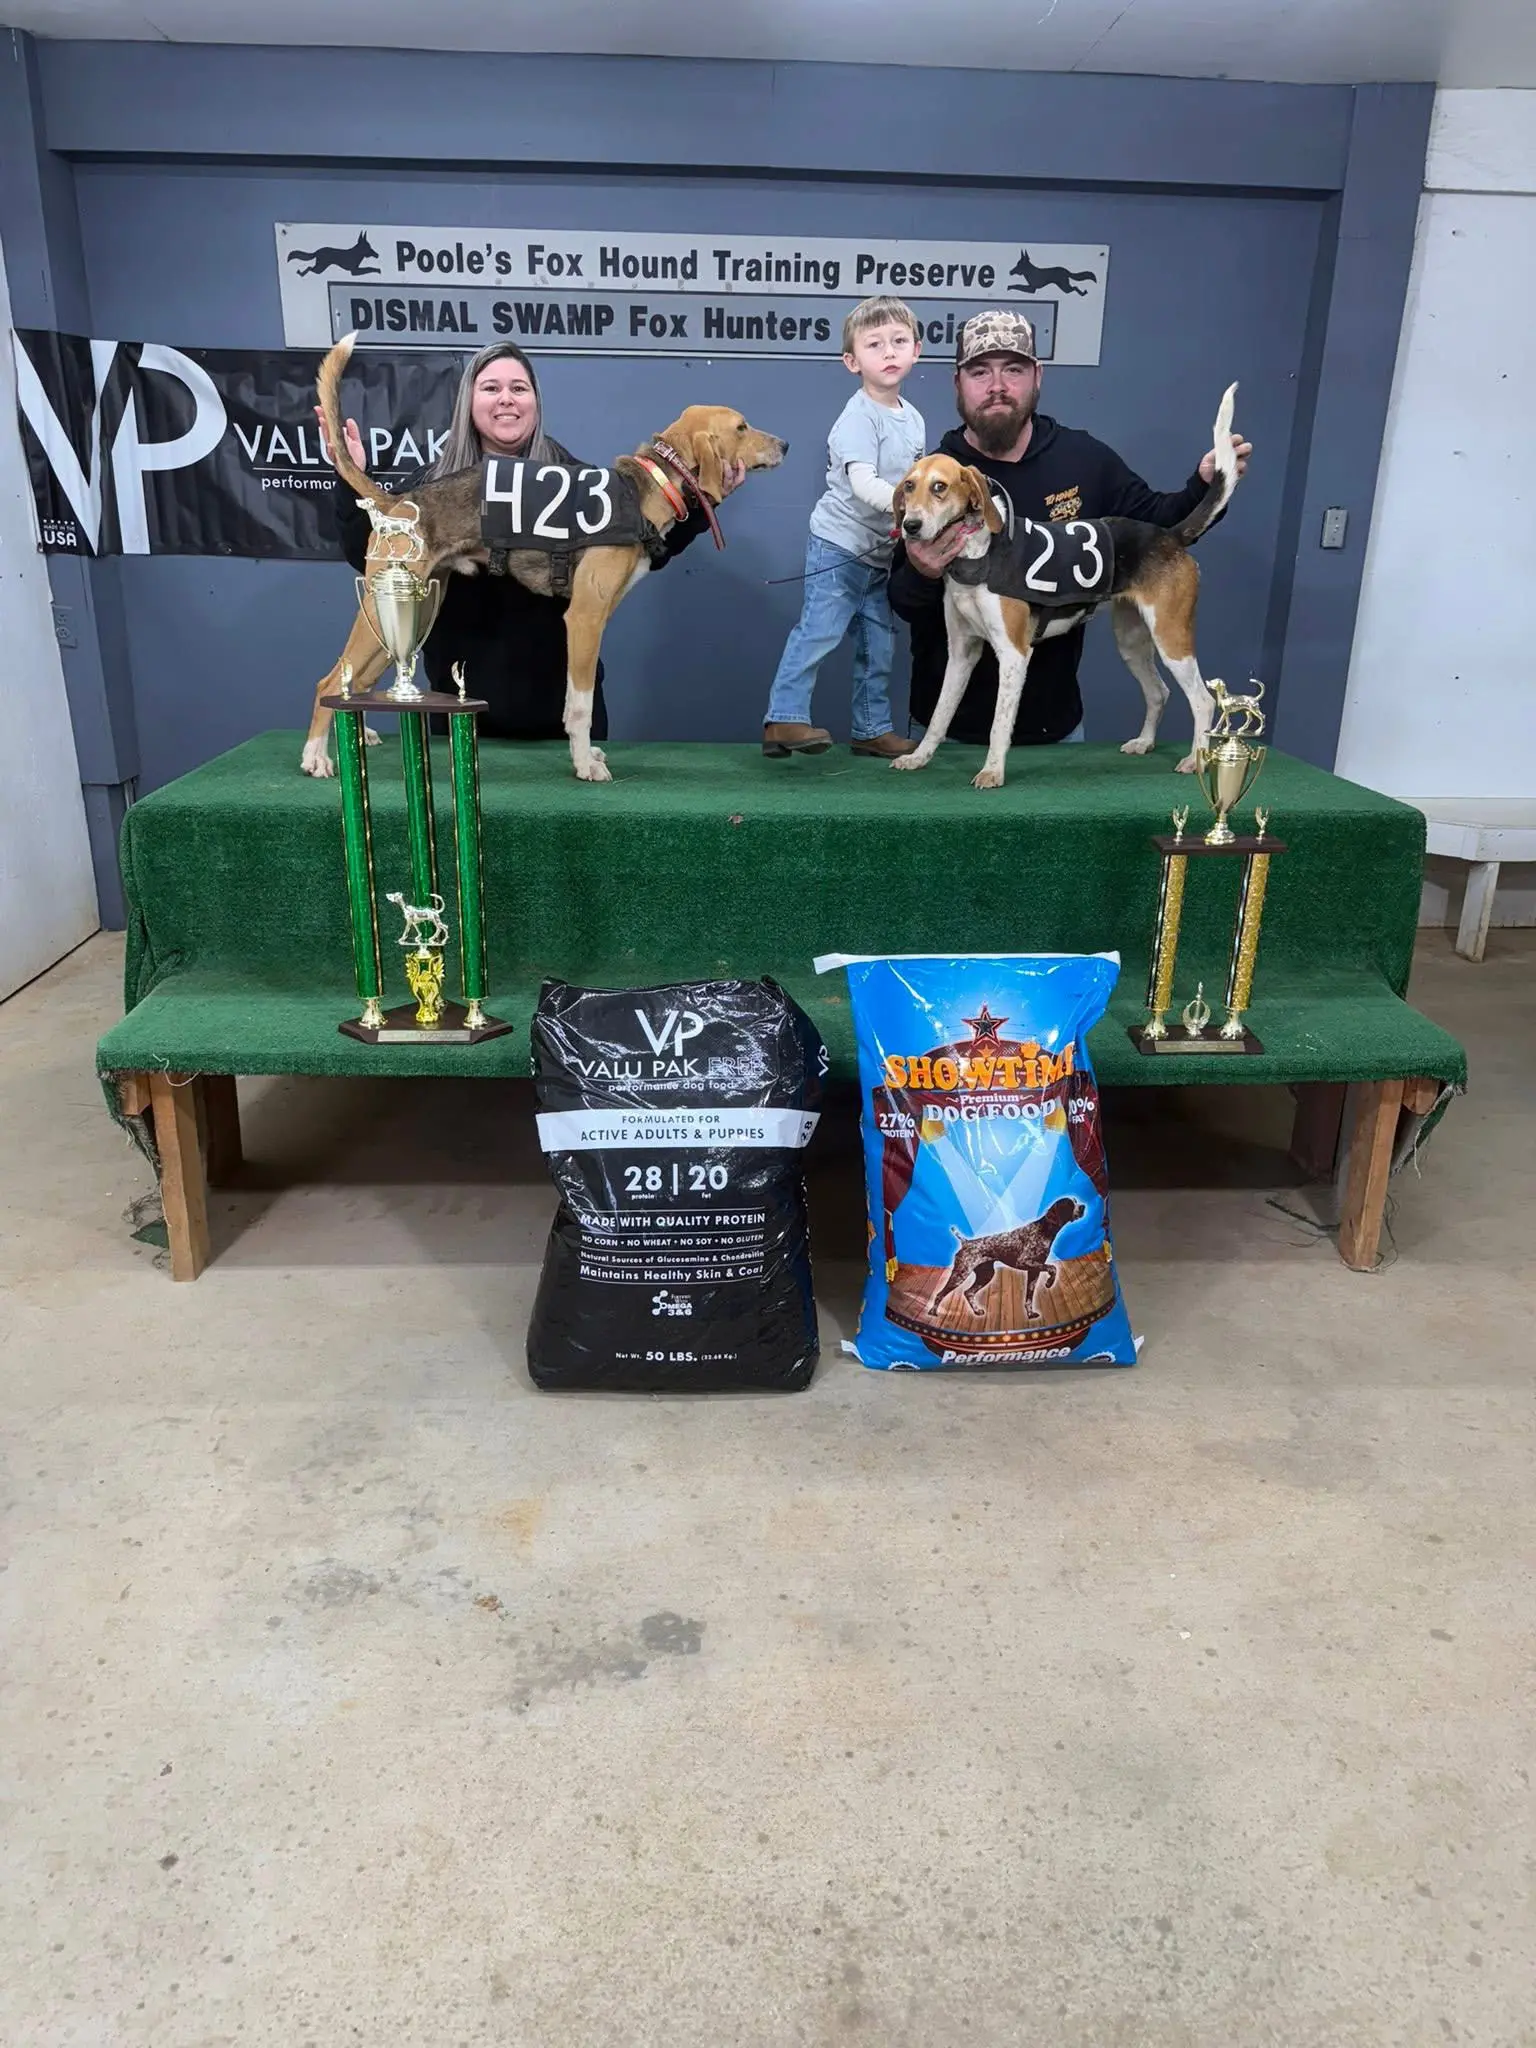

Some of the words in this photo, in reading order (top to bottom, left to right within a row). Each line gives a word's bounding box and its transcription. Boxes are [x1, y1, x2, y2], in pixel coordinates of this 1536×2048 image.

[396, 241, 512, 275] Poole's
[527, 245, 584, 277] Fox
[600, 247, 698, 280] Hound
[713, 250, 841, 290] Training
[856, 254, 995, 288] Preserve
[350, 298, 478, 333] DISMAL
[492, 303, 614, 337] SWAMP
[629, 306, 688, 338] Fox
[704, 307, 831, 342] Hunters
[12, 329, 228, 556] VP
[370, 427, 451, 467] PAK
[261, 474, 337, 491] performa
[485, 459, 612, 539] 423
[43, 530, 77, 547] USA
[1025, 517, 1104, 593] 23
[635, 1009, 704, 1057] VP
[578, 1060, 642, 1079] VALU
[653, 1058, 699, 1077] PAK
[608, 1082, 679, 1093] performance
[683, 1080, 705, 1092] dog
[709, 1080, 735, 1091] food
[959, 1094, 1020, 1105] Premium
[1069, 1097, 1095, 1114] 0%
[925, 1104, 978, 1122] DOG
[985, 1099, 1057, 1121] FOOD
[622, 1115, 694, 1124] FORMULATED
[699, 1115, 720, 1124] FOR
[879, 1113, 916, 1128] 27%
[581, 1130, 628, 1141] ACTIVE
[634, 1129, 688, 1140] ADULTS
[694, 1129, 701, 1139] &
[709, 1128, 765, 1140] PUPPIES
[624, 1165, 662, 1191] 28
[688, 1165, 728, 1190] 20
[580, 1213, 616, 1227] MADE
[619, 1216, 651, 1227] WITH
[656, 1215, 710, 1227] QUALITY
[715, 1213, 766, 1225] PROTEIN
[594, 1238, 618, 1246] CORN
[736, 1233, 764, 1243] GLUTEN
[580, 1251, 609, 1262] Natural
[612, 1255, 642, 1263] Sources
[645, 1255, 654, 1263] of
[657, 1254, 709, 1263] Glucosamine
[580, 1265, 639, 1279] Maintains
[644, 1270, 691, 1281] Healthy
[696, 1268, 721, 1279] Skin
[726, 1267, 734, 1277] &
[739, 1264, 763, 1276] Coat
[660, 1302, 692, 1310] OMEGA
[645, 1351, 665, 1361] 50
[669, 1351, 698, 1361] LBS.
[941, 1346, 1072, 1364] Performance
